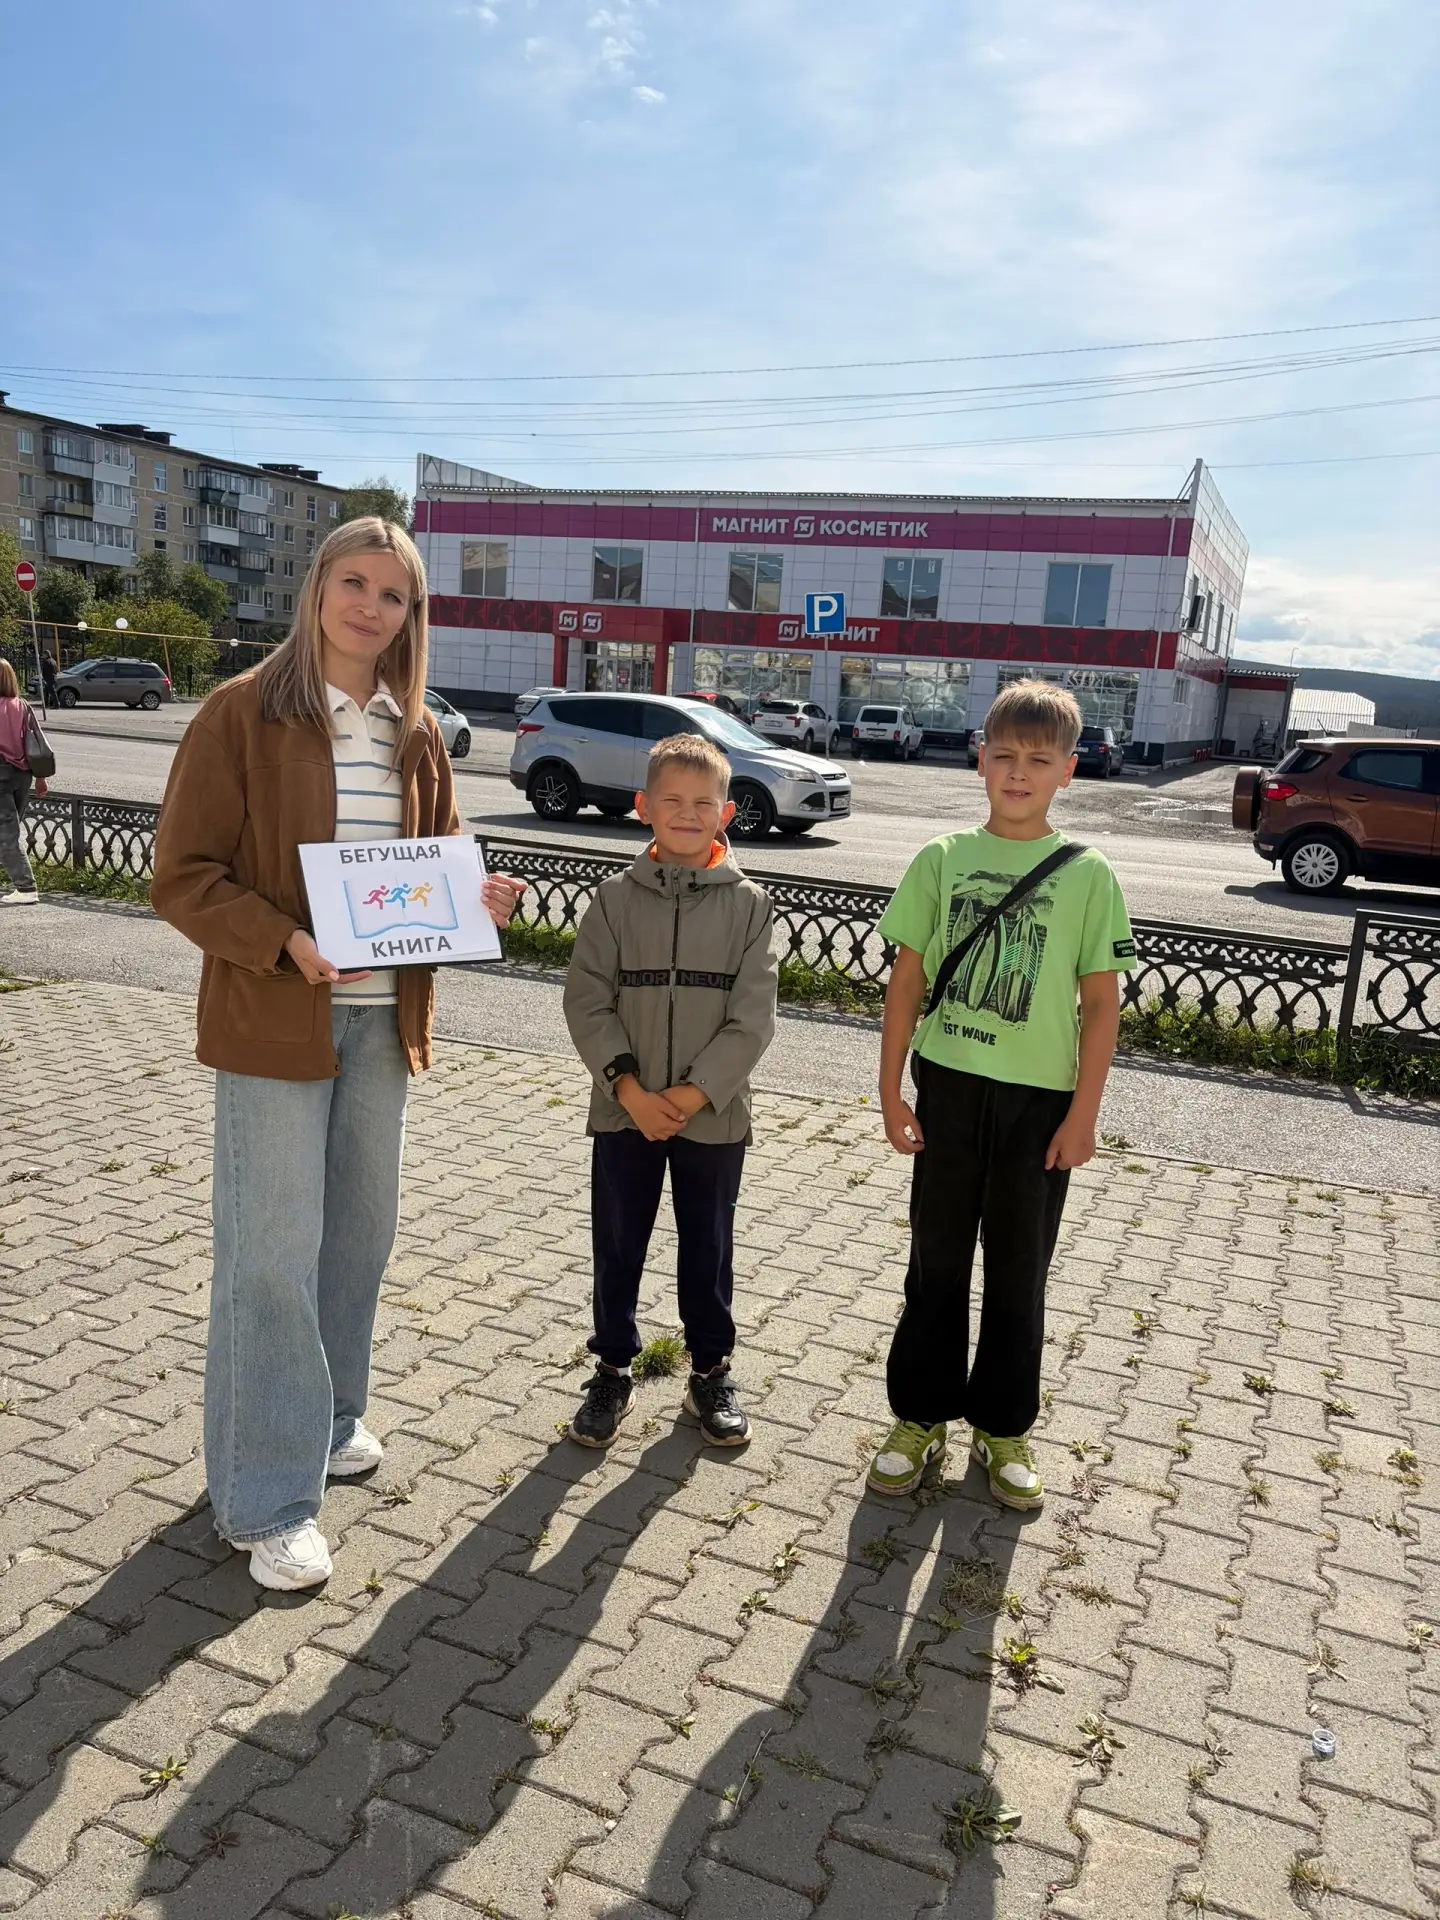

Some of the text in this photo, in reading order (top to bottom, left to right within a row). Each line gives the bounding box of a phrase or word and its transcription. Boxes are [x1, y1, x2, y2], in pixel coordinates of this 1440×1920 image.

[712, 517, 928, 538] МАГНИТ КОСМЕТИК
[813, 595, 838, 631] P
[339, 844, 441, 864] БЕГУЩАЯ
[371, 935, 452, 958] КНИГА
[962, 1025, 997, 1046] WAVE
